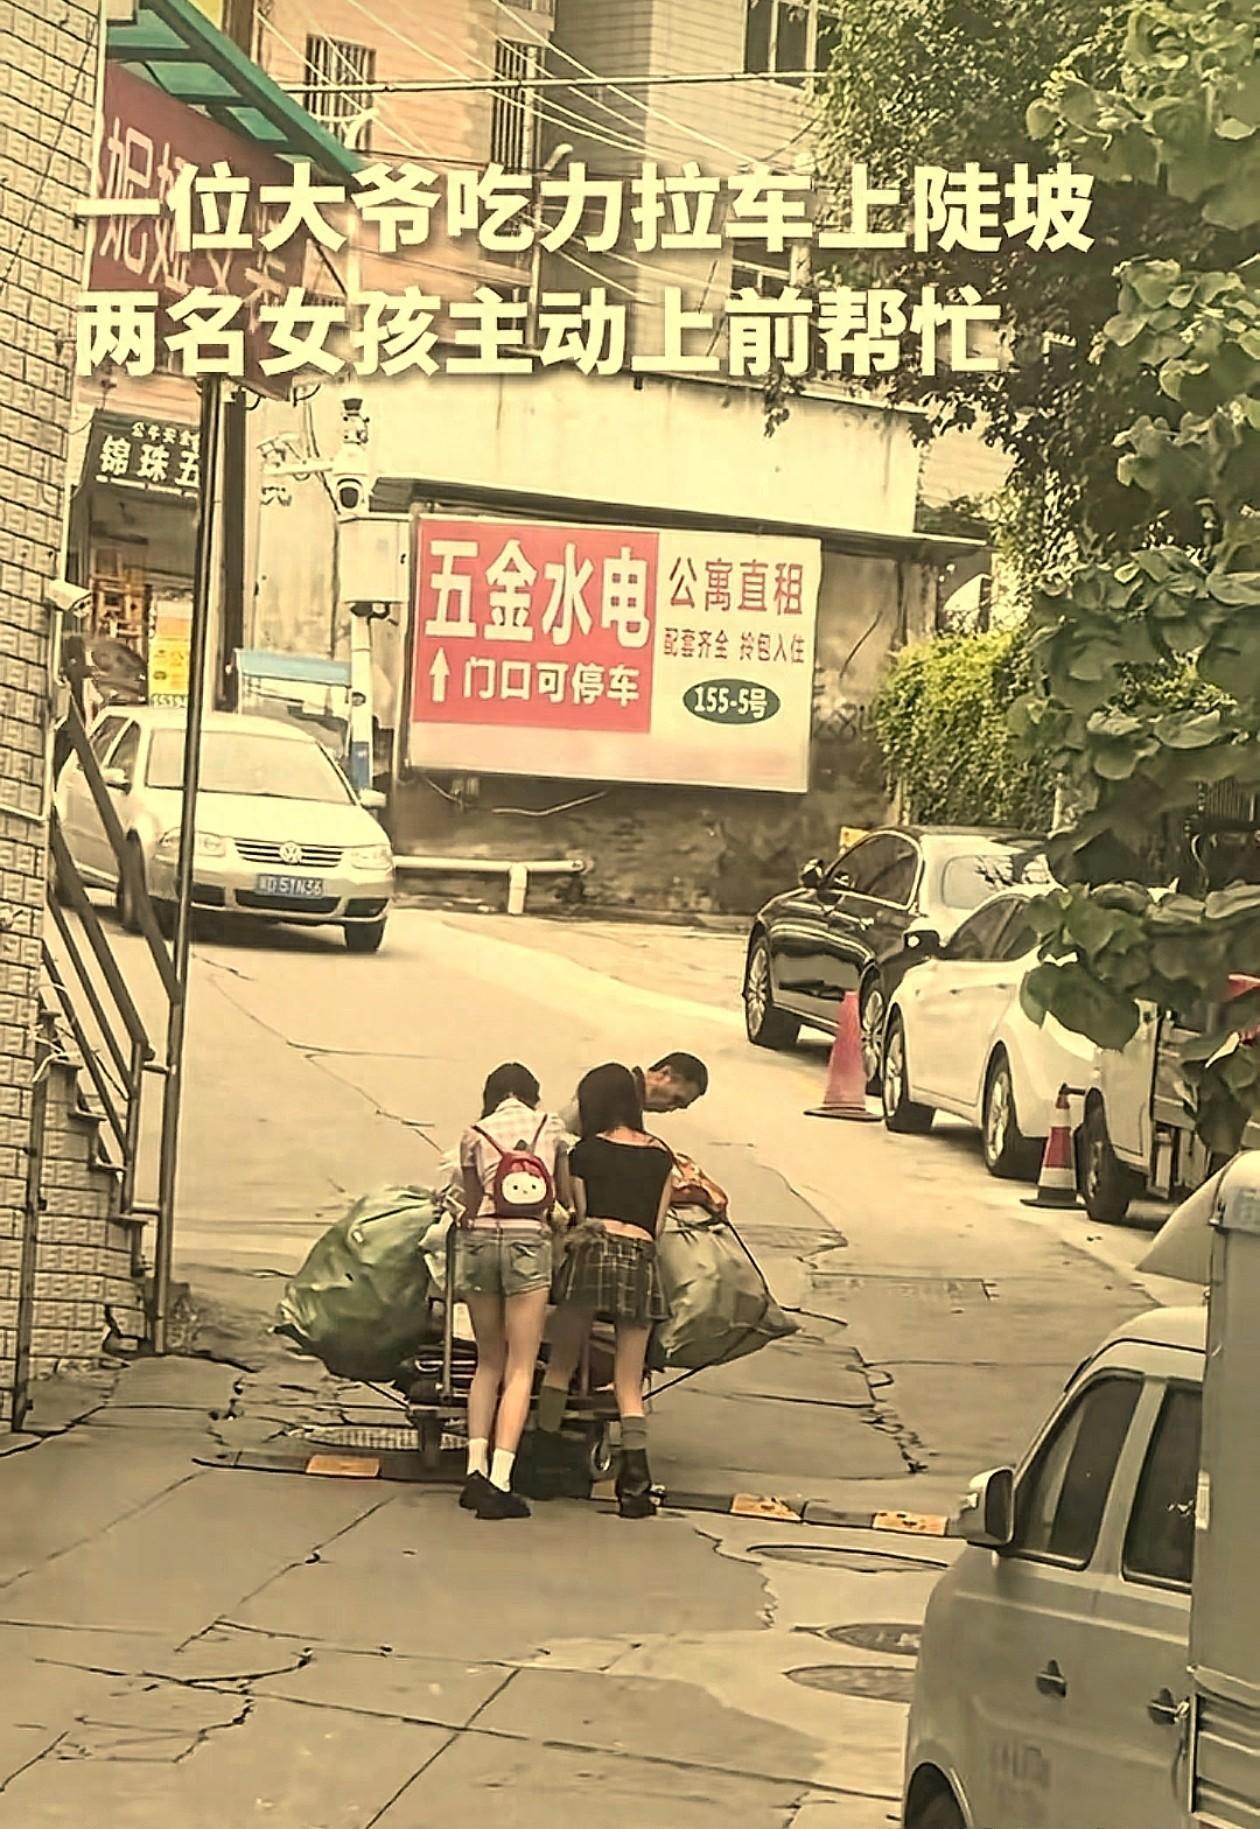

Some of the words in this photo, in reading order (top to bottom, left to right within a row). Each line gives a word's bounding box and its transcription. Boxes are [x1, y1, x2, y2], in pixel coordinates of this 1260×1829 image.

[425, 539, 650, 648] 五金水电
[669, 557, 803, 616] 公寓直租
[663, 627, 728, 659] 配套齐全
[463, 656, 640, 707] 门口可停车
[694, 686, 768, 719] 155-5号
